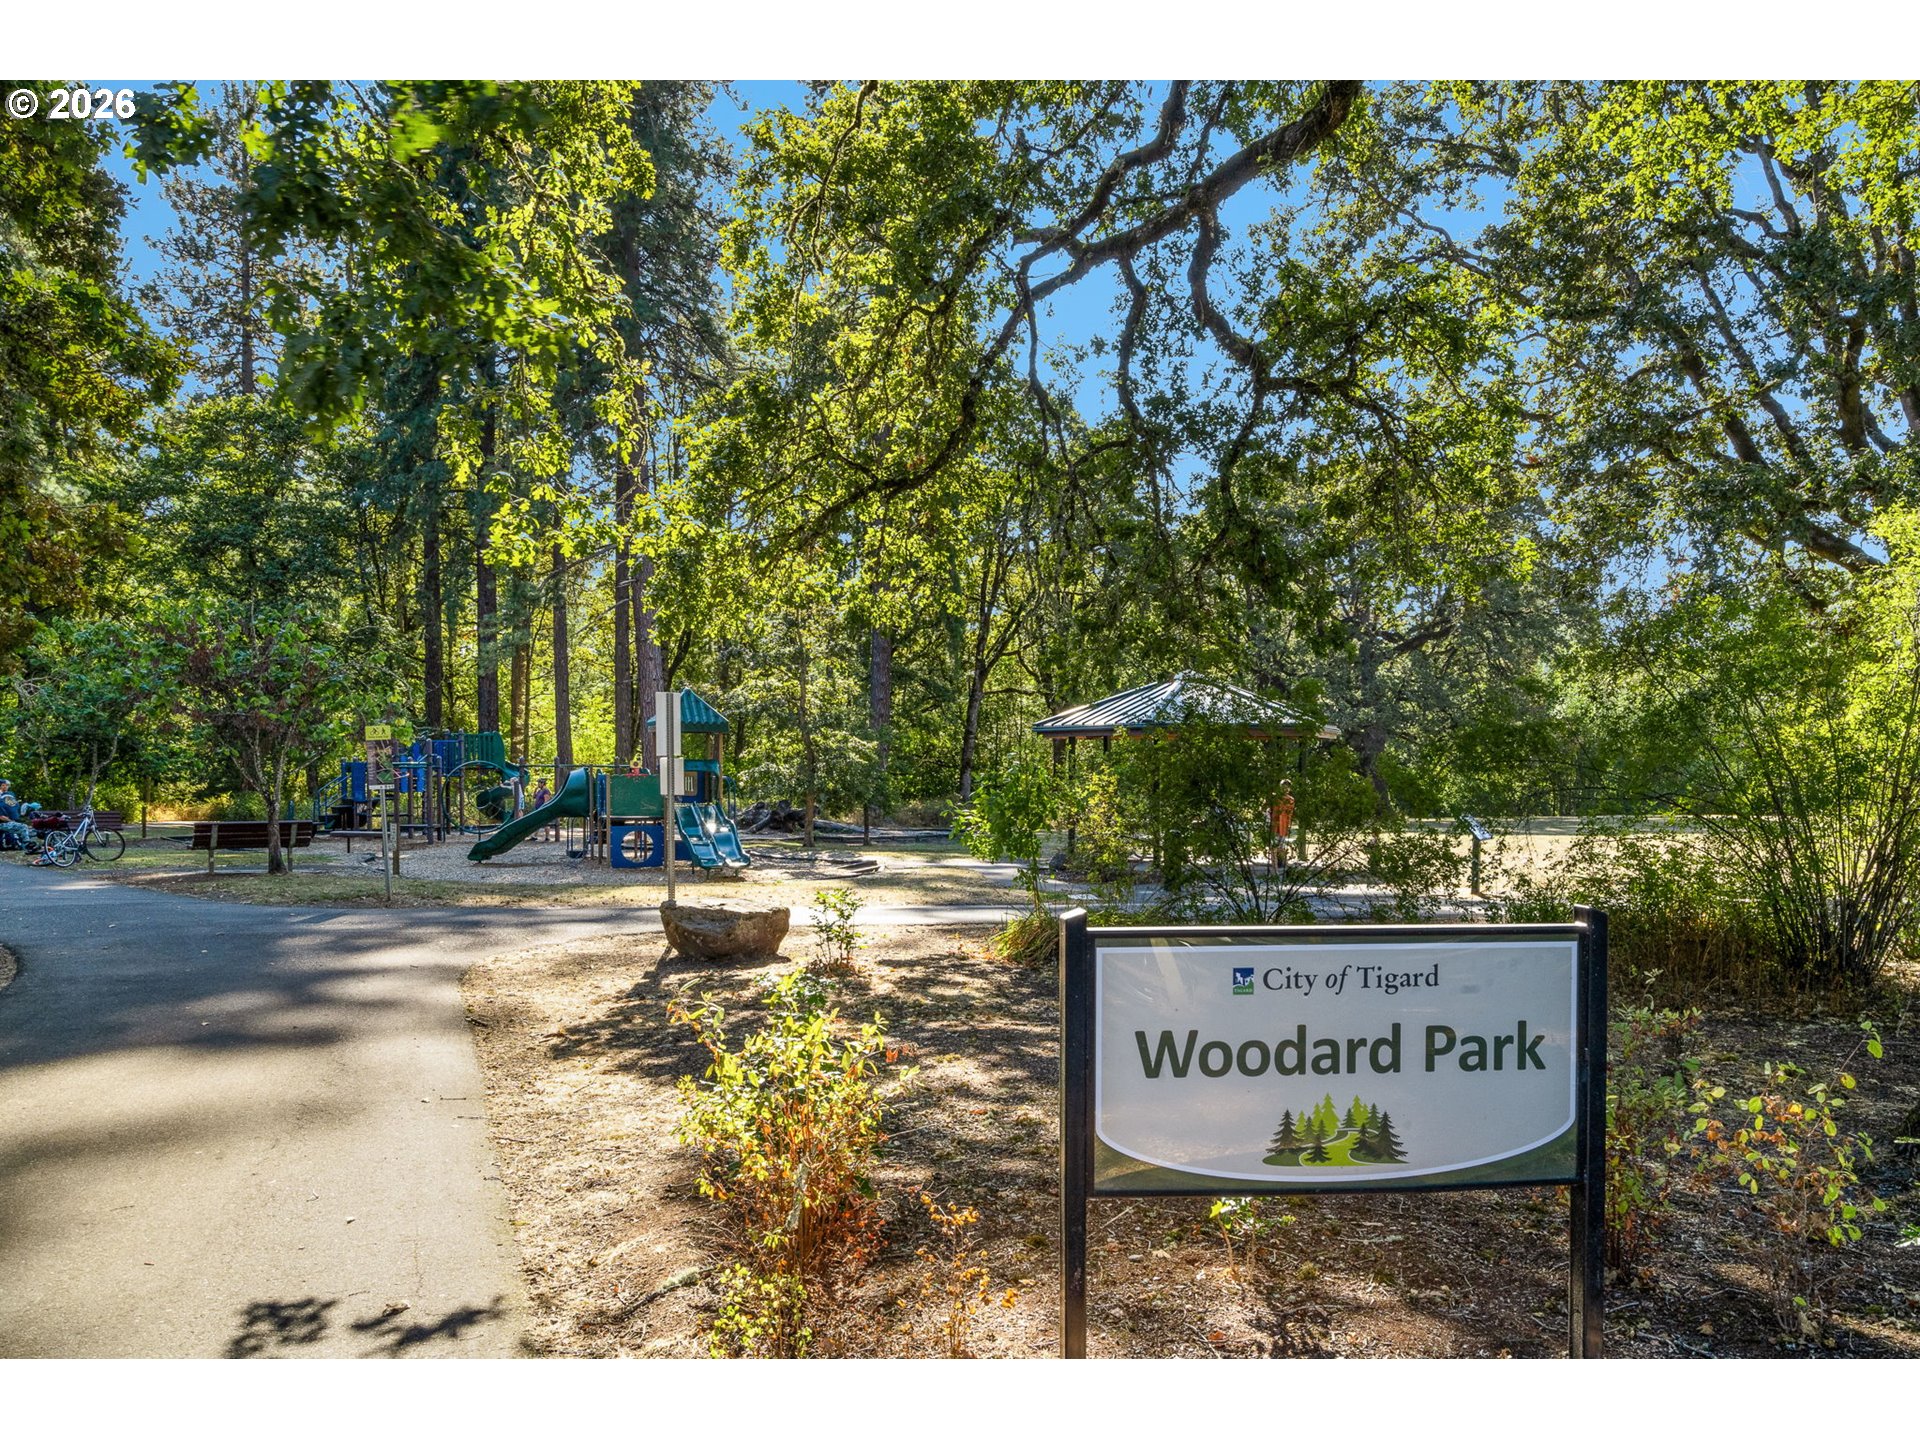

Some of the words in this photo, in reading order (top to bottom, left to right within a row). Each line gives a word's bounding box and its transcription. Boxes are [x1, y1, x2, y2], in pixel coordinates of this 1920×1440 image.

[1262, 967, 1319, 997] City
[1325, 964, 1353, 996] of
[1356, 963, 1440, 996] Tigard
[1134, 1023, 1402, 1079] Woodard
[1425, 1019, 1547, 1073] Park
